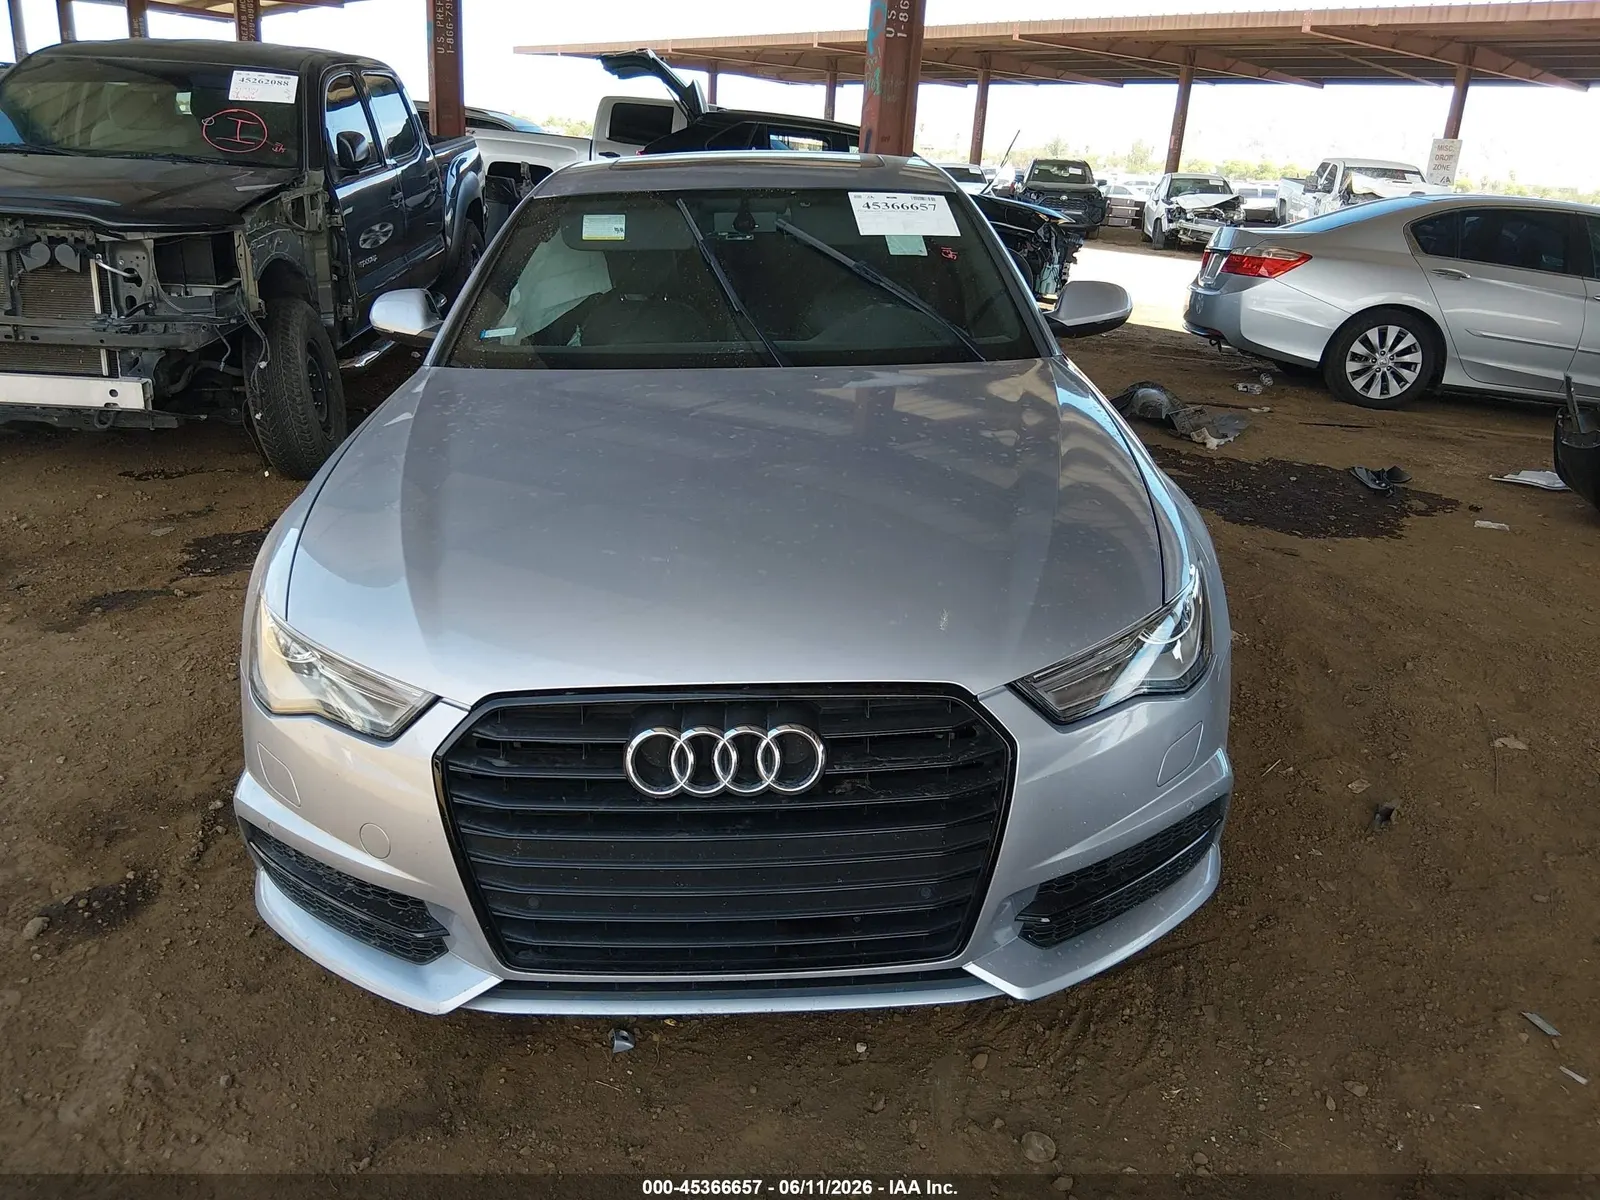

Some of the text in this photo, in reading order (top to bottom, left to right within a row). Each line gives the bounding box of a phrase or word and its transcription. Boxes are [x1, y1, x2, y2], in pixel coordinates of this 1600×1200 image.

[445, 0, 455, 54] 1-866-79
[239, 77, 289, 86] 45262088
[1432, 163, 1451, 171] ZONE
[862, 201, 936, 211] 45366657
